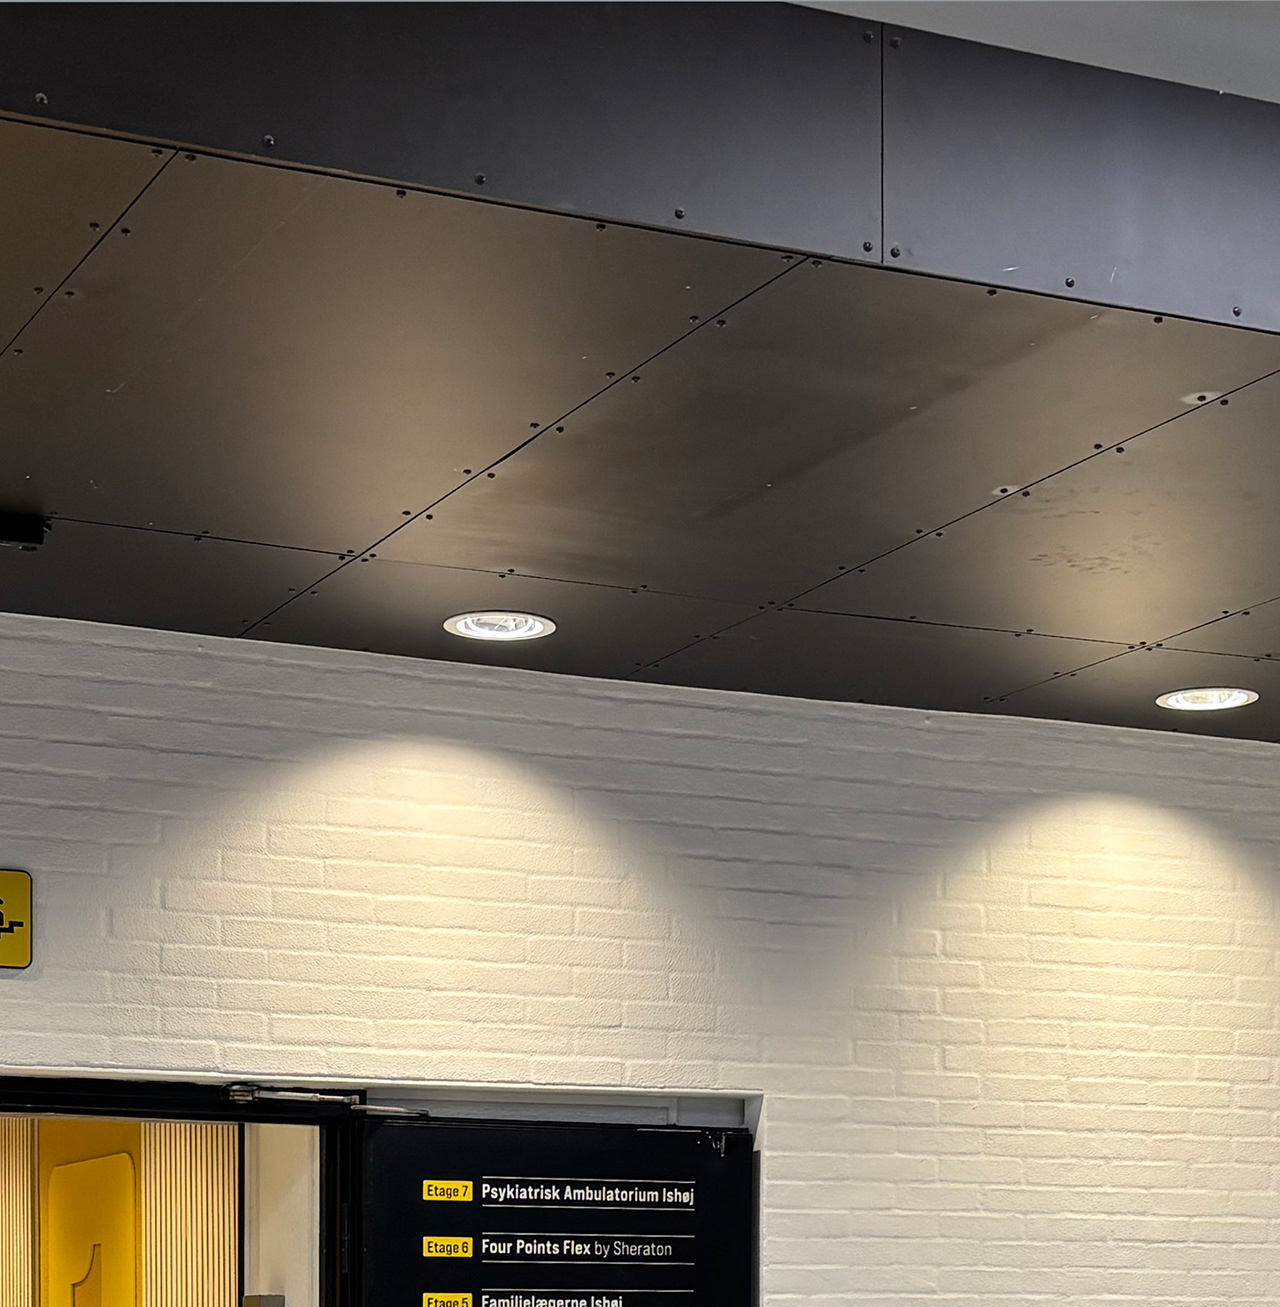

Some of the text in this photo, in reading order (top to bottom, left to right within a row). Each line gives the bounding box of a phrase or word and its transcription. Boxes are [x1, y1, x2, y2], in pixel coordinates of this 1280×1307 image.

[427, 1185, 469, 1198] Etage 7
[482, 1184, 693, 1205] Psykiatrisk Ambulatorium Ishøj
[427, 1242, 469, 1255] Etage 6
[482, 1239, 672, 1258] Four Points Flex by Sheraton
